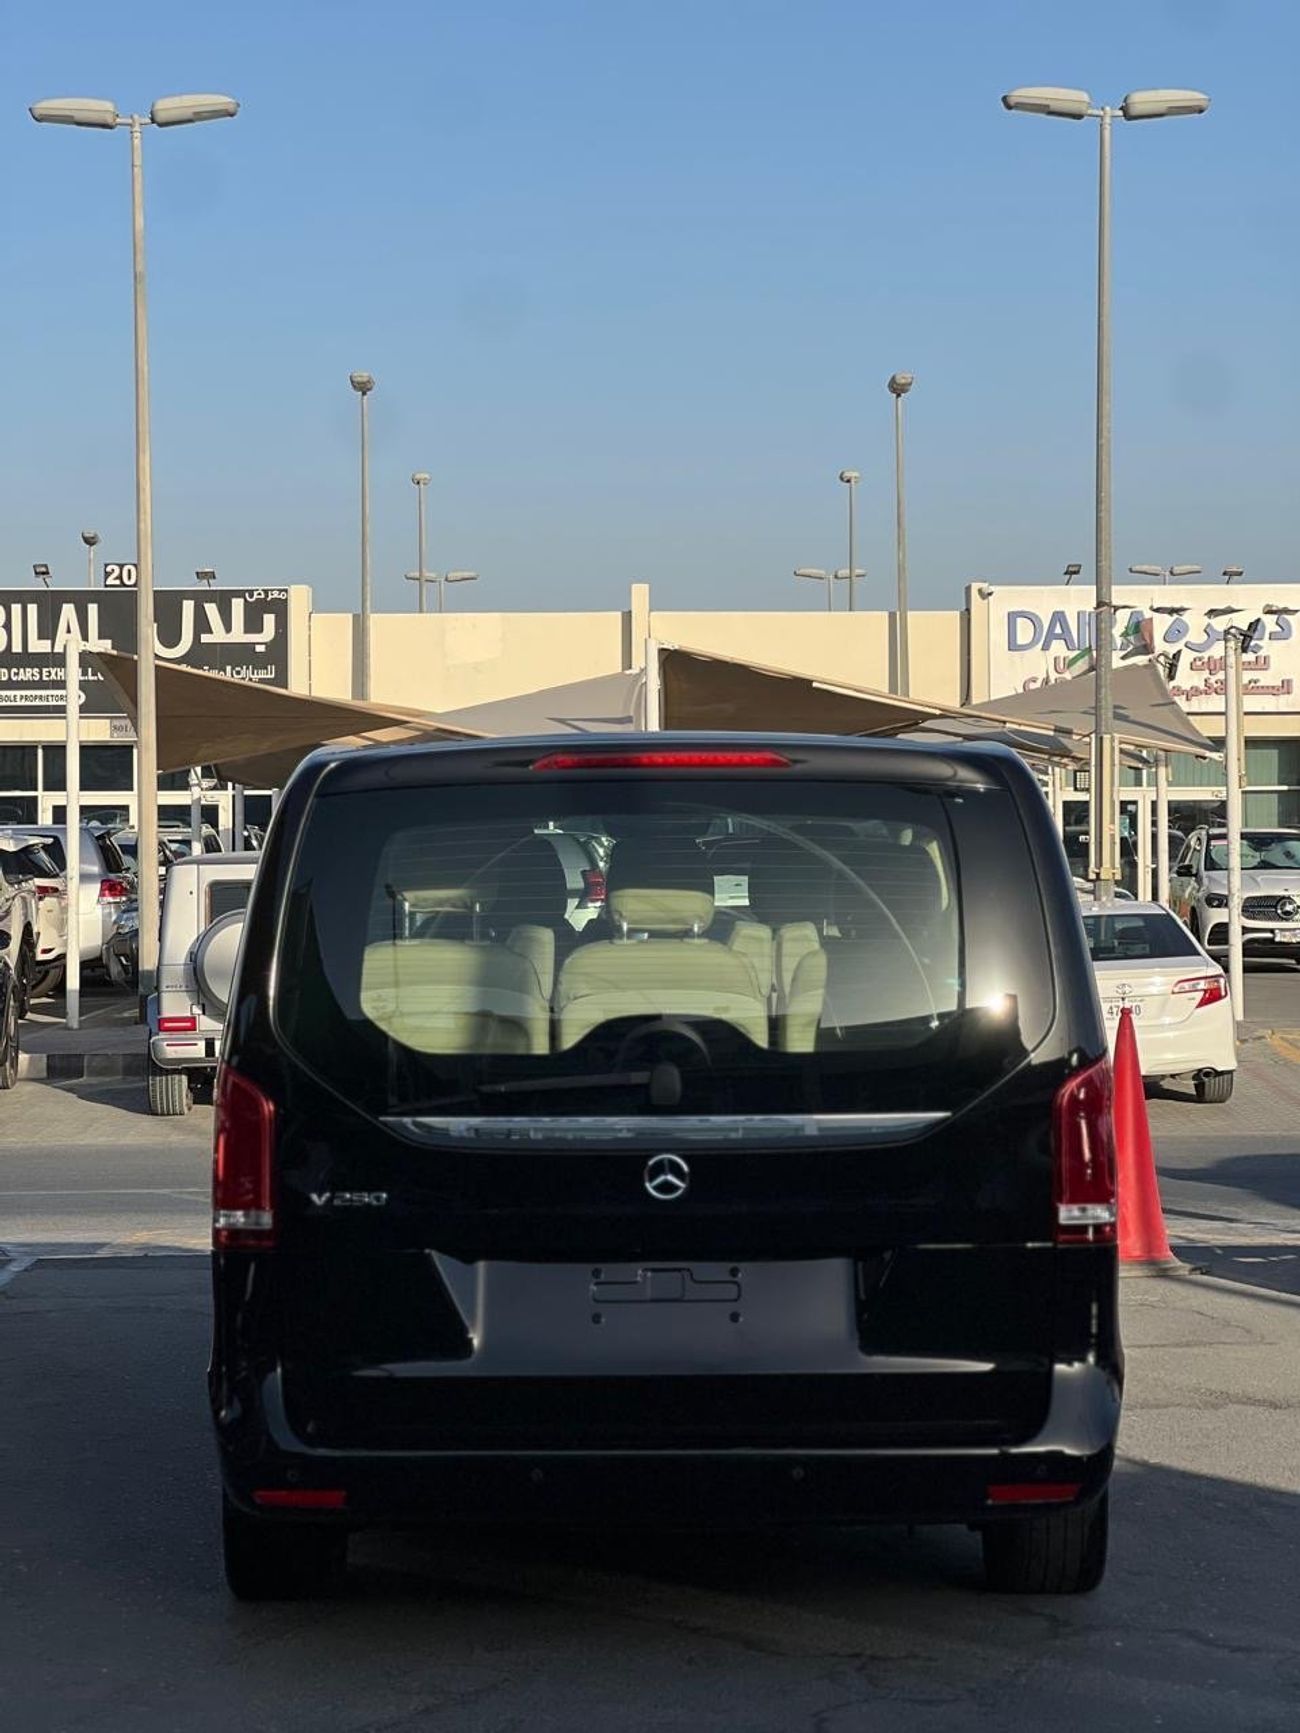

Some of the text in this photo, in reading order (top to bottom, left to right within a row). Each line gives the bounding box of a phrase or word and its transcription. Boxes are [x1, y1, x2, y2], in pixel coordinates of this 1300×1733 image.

[105, 564, 137, 586] 20
[245, 589, 287, 603] معرض
[10, 667, 41, 681] CARS
